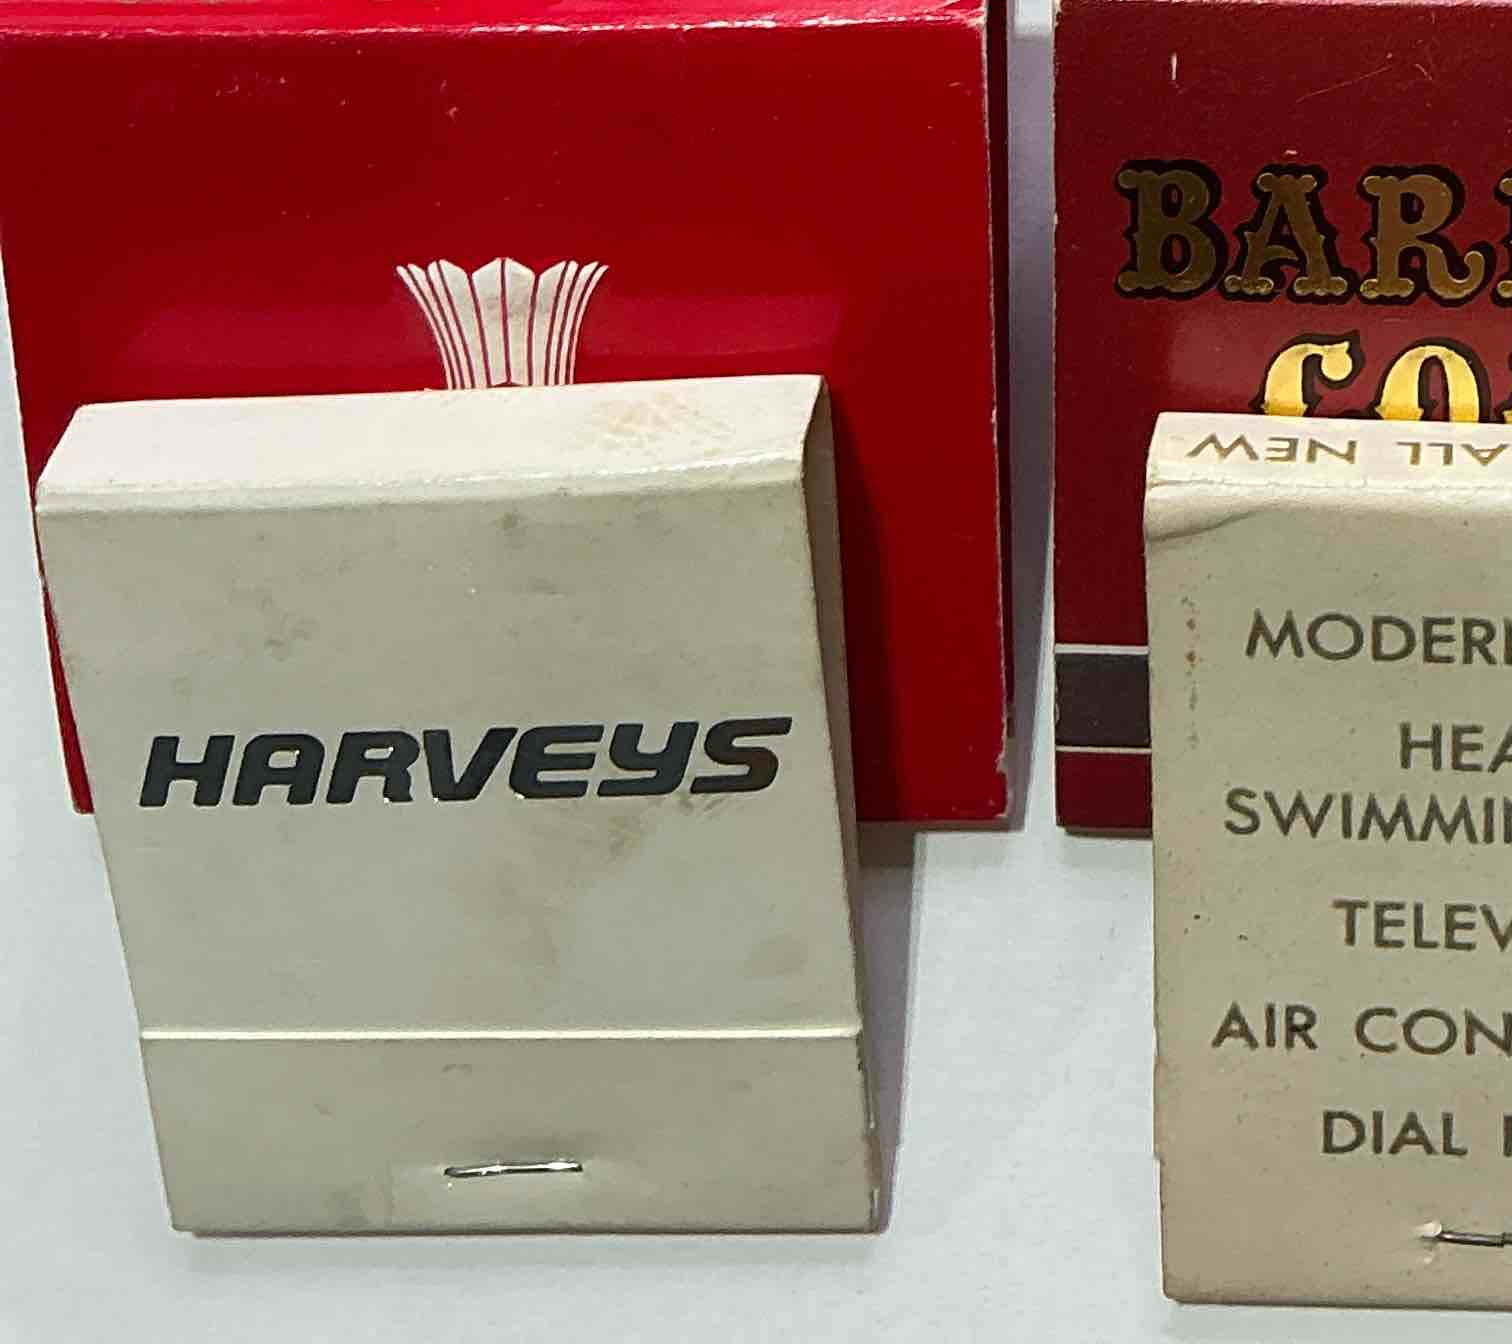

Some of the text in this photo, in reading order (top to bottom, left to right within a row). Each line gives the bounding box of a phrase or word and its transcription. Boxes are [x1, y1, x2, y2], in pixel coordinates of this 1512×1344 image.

[1185, 433, 1358, 466] NEW
[1396, 441, 1506, 468] ALL
[137, 716, 794, 809] HARVEYS
[1209, 1003, 1319, 1052] AIR
[1321, 1111, 1469, 1157] DIAL
